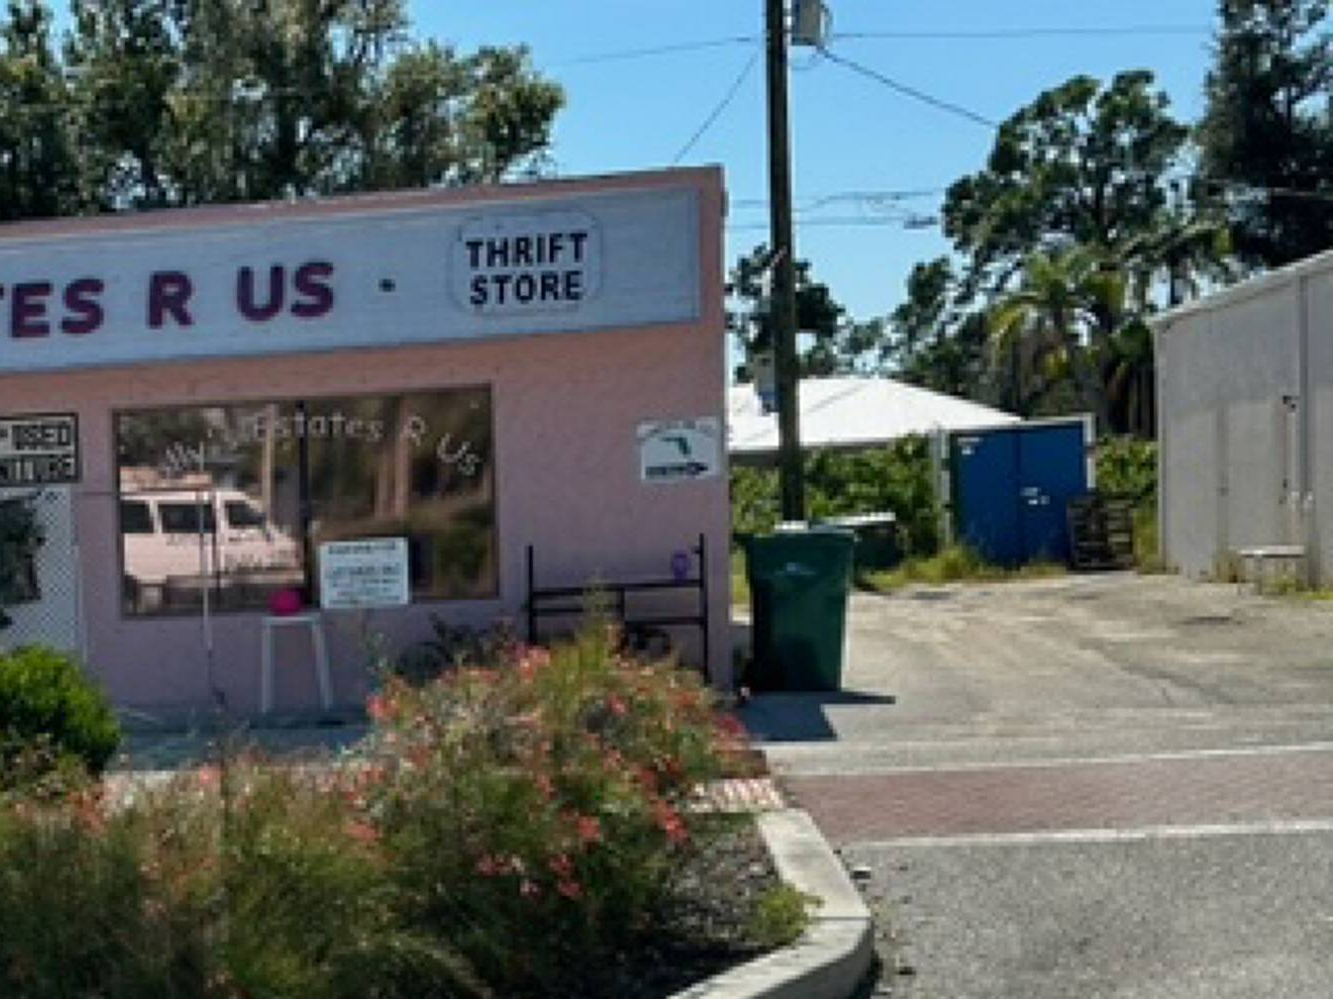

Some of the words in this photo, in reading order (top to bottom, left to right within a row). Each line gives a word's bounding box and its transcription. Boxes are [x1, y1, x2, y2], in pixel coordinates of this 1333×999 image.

[466, 231, 588, 268] THRIFT
[145, 268, 194, 329] R
[236, 261, 335, 323] US
[470, 270, 583, 305] STORE
